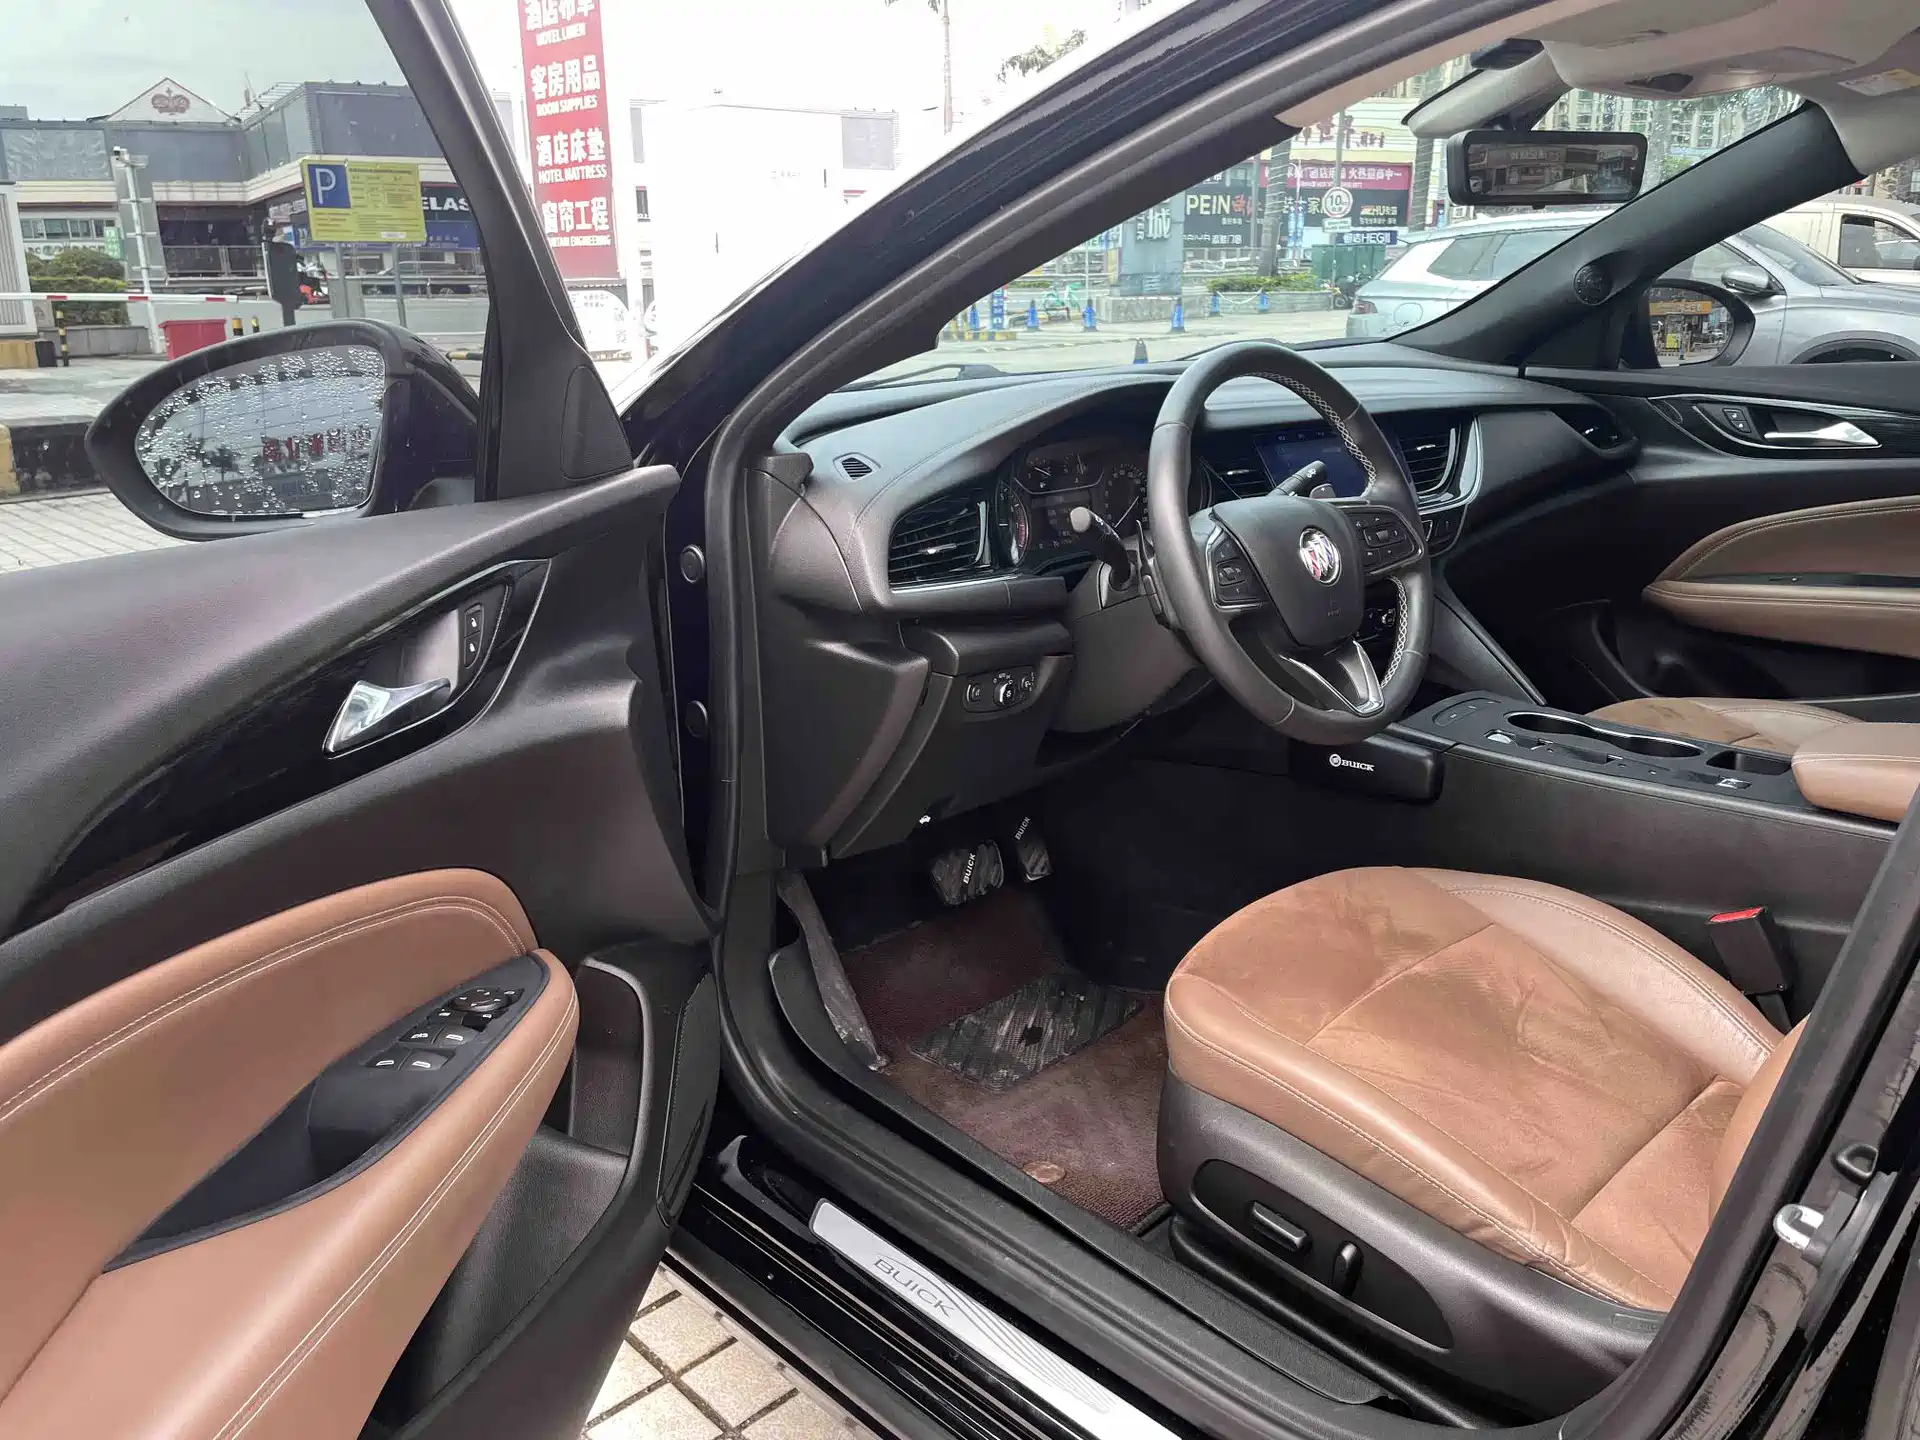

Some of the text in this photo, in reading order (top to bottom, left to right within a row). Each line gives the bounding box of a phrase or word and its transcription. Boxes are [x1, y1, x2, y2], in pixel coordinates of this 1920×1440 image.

[530, 54, 601, 101] 客房用品
[536, 127, 606, 167] 酒店床垫
[315, 168, 336, 205] P
[538, 164, 607, 184] HOTEL MATTRESS
[541, 196, 610, 233] 窗帘工程
[1186, 194, 1231, 215] PEIN
[1329, 194, 1342, 207] 10
[1147, 207, 1172, 239] 城
[1341, 759, 1375, 772] BUICK
[1014, 816, 1031, 840] BUICK
[963, 853, 976, 884] BUICK
[874, 1259, 956, 1318] BUICK
